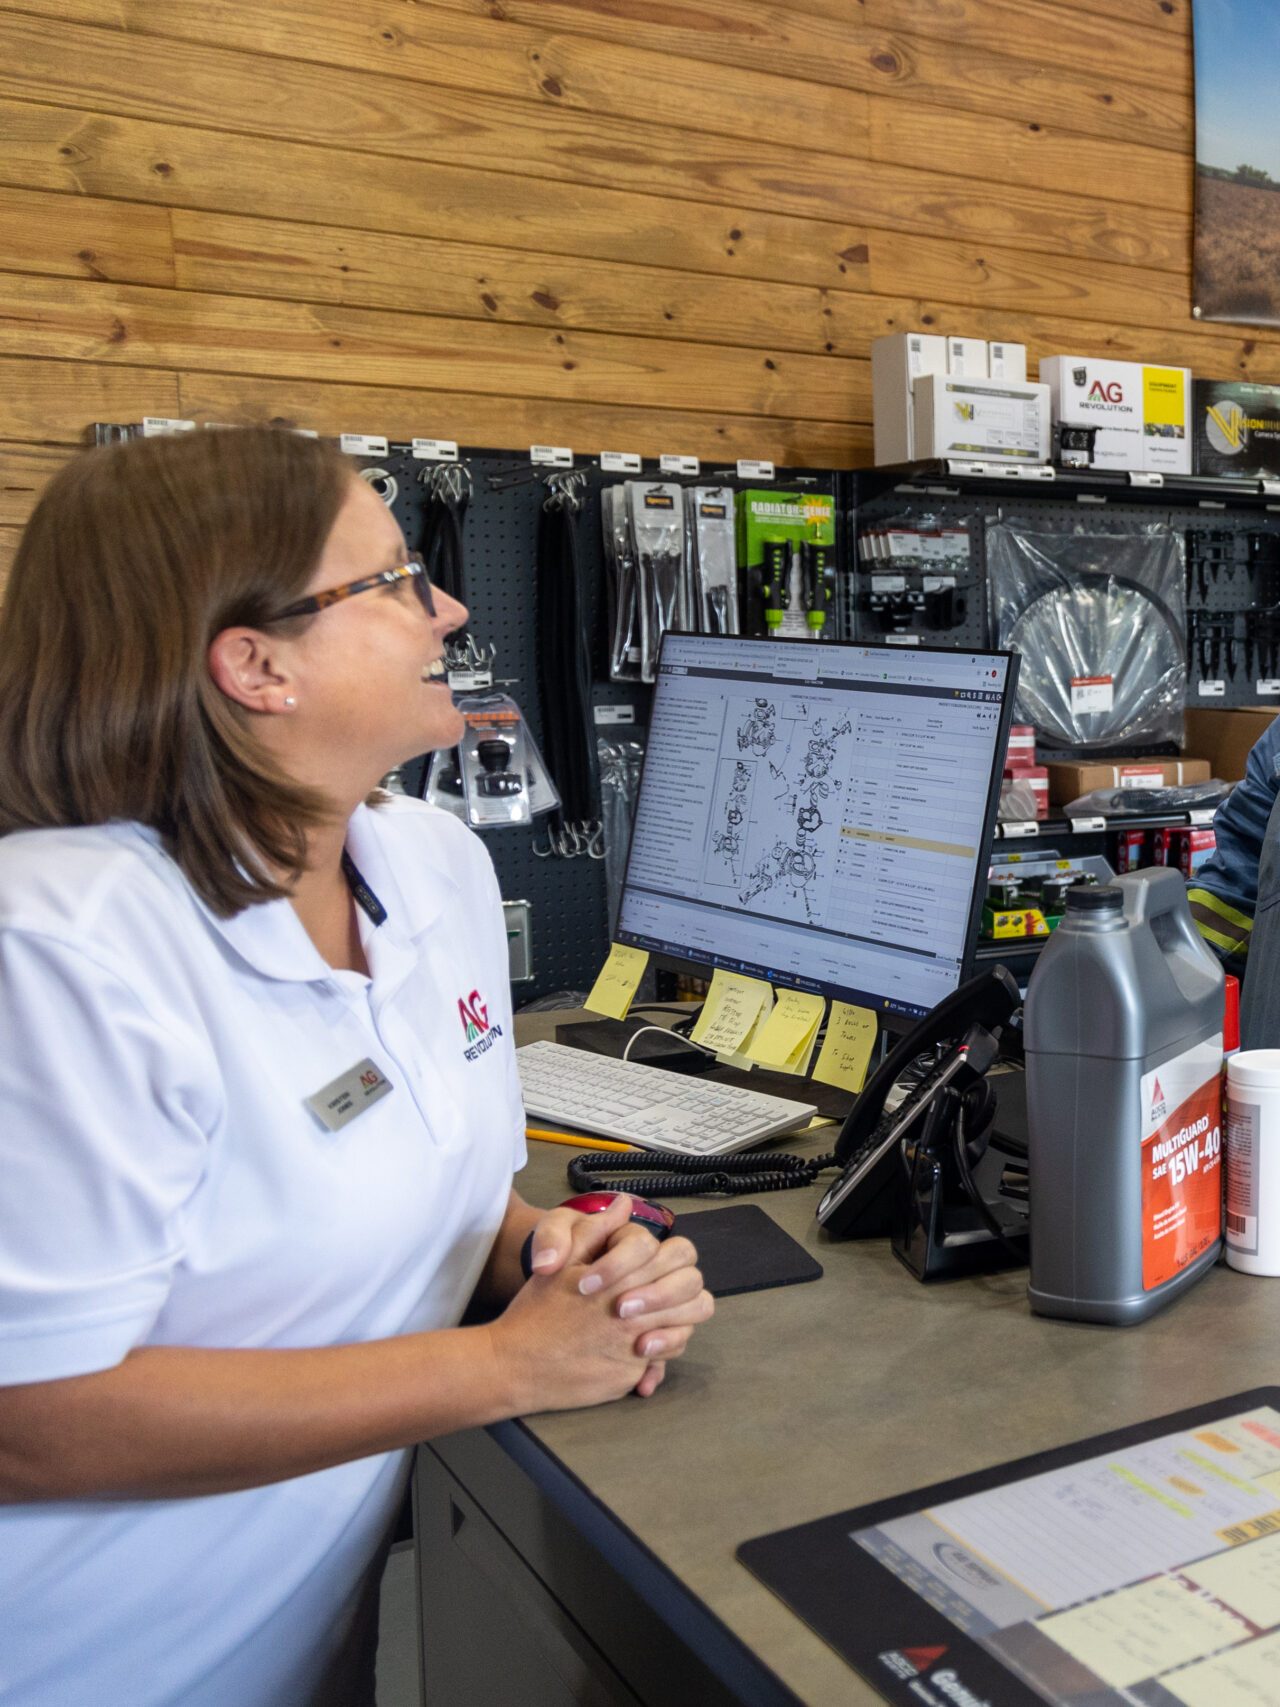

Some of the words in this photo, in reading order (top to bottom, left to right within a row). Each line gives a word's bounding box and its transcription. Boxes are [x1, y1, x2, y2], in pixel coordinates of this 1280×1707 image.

[1079, 401, 1133, 414] REVOLUTION
[1087, 380, 1123, 403] AG
[457, 988, 490, 1043] AG
[1152, 1163, 1168, 1180] SAE
[1168, 1126, 1220, 1186] 15W-40
